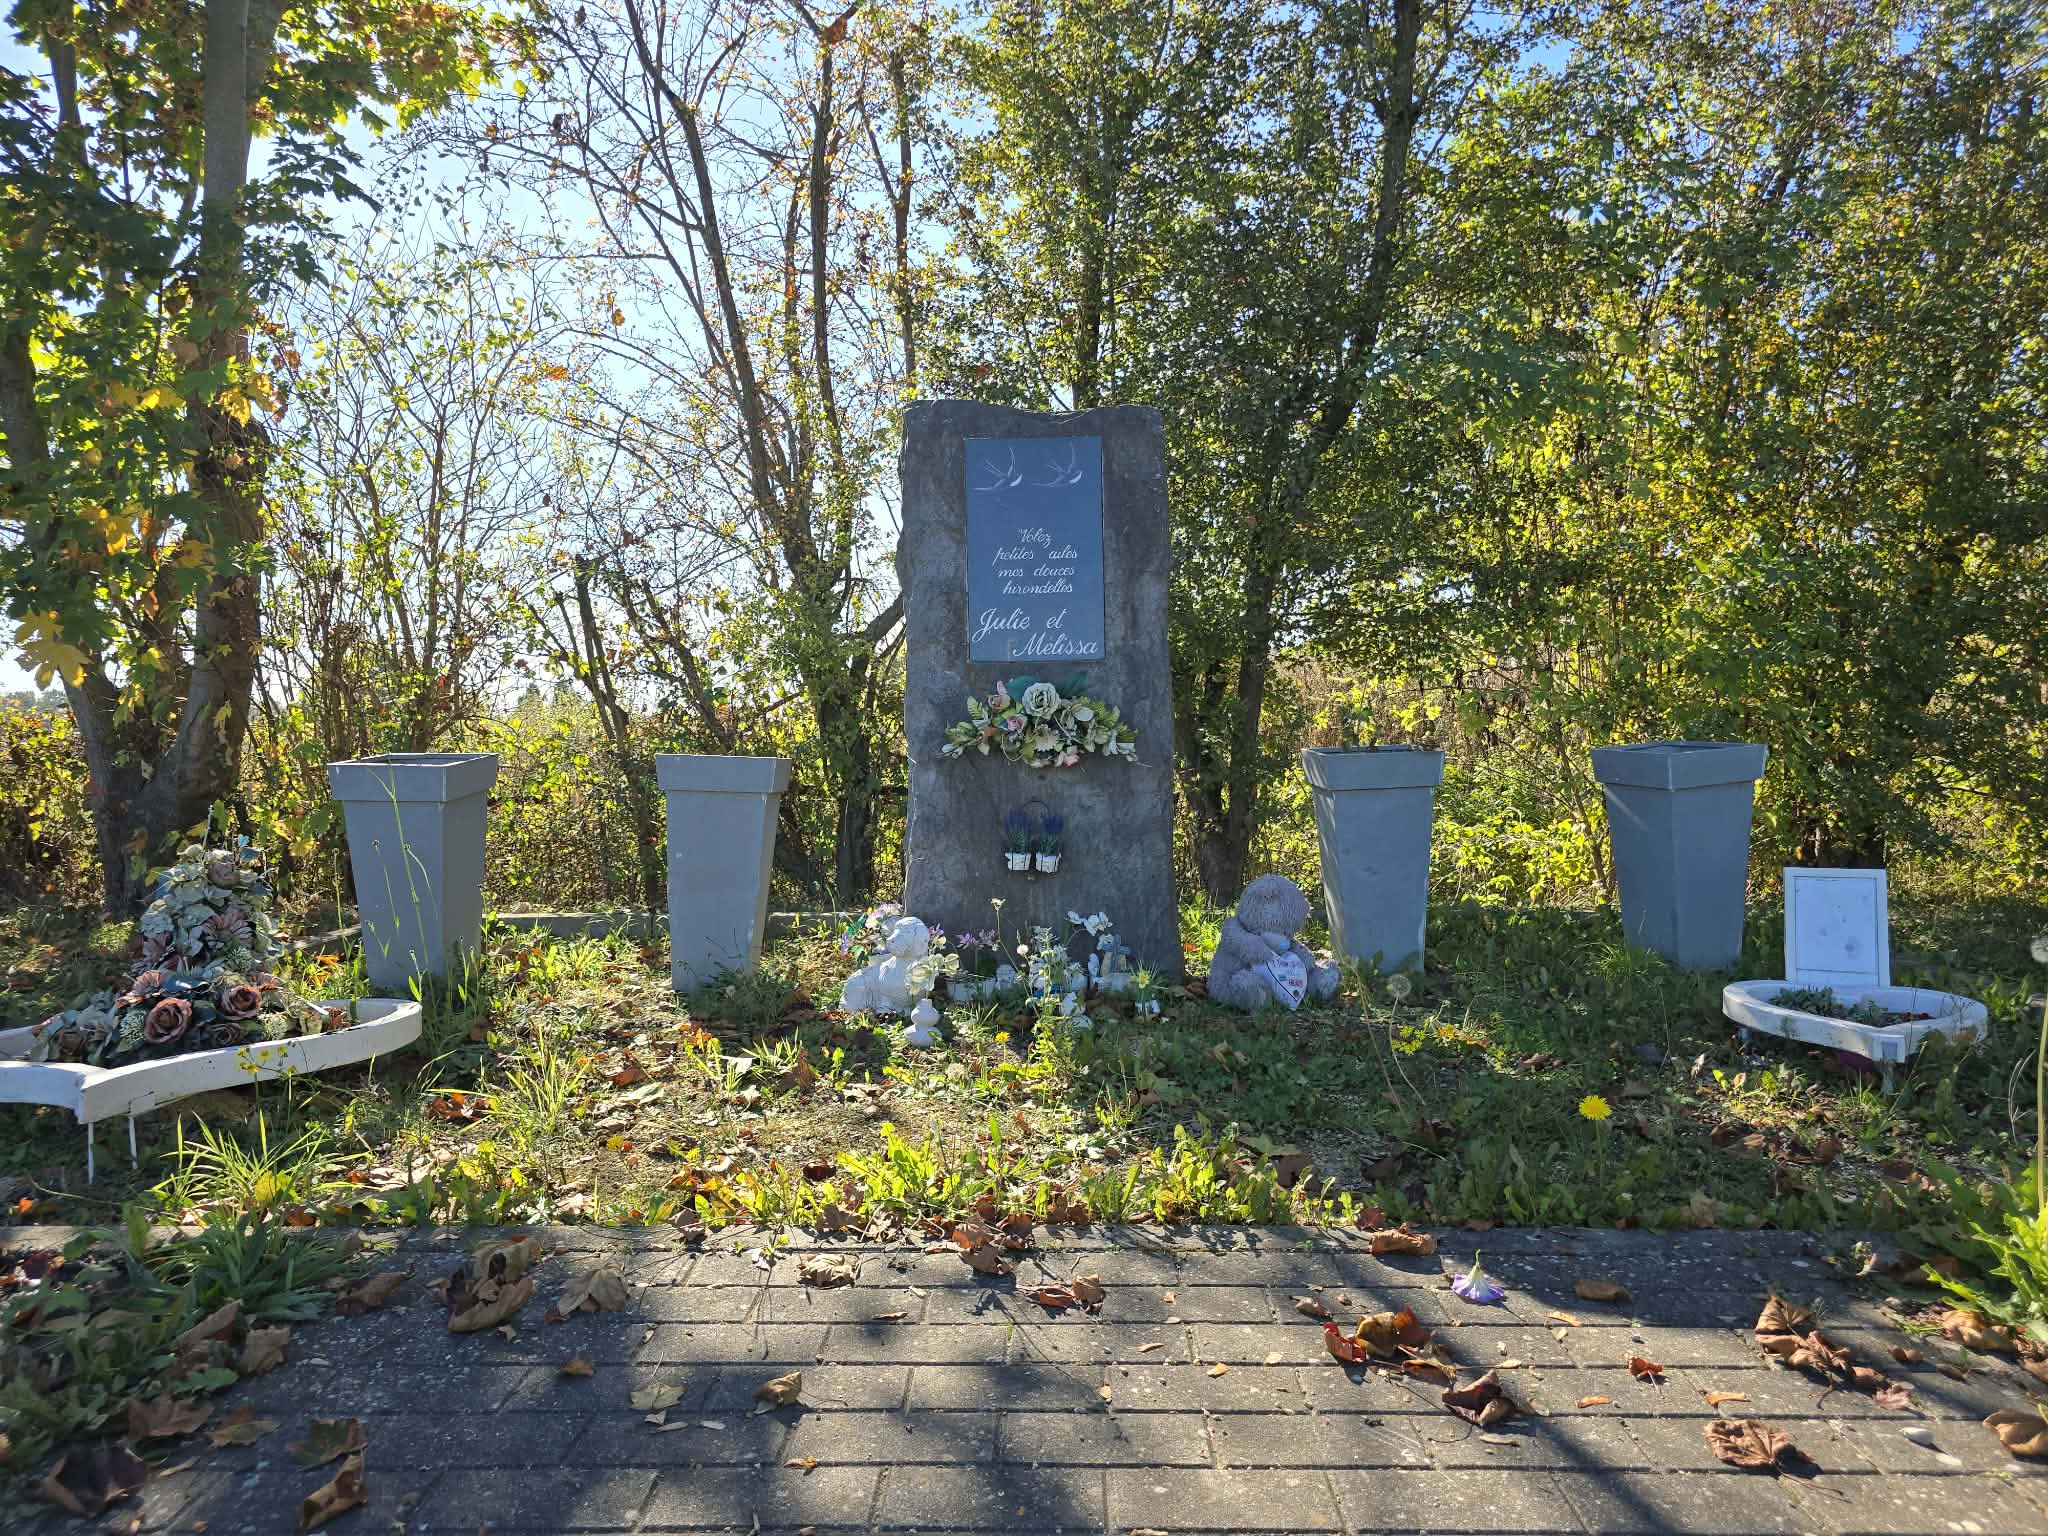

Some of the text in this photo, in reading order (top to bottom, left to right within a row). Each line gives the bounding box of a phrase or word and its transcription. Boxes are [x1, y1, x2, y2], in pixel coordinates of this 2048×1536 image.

[992, 544, 1077, 566] petites ailes
[998, 563, 1075, 579] mes douces
[1002, 577, 1073, 595] hirondelles
[971, 607, 1070, 643] Julie et
